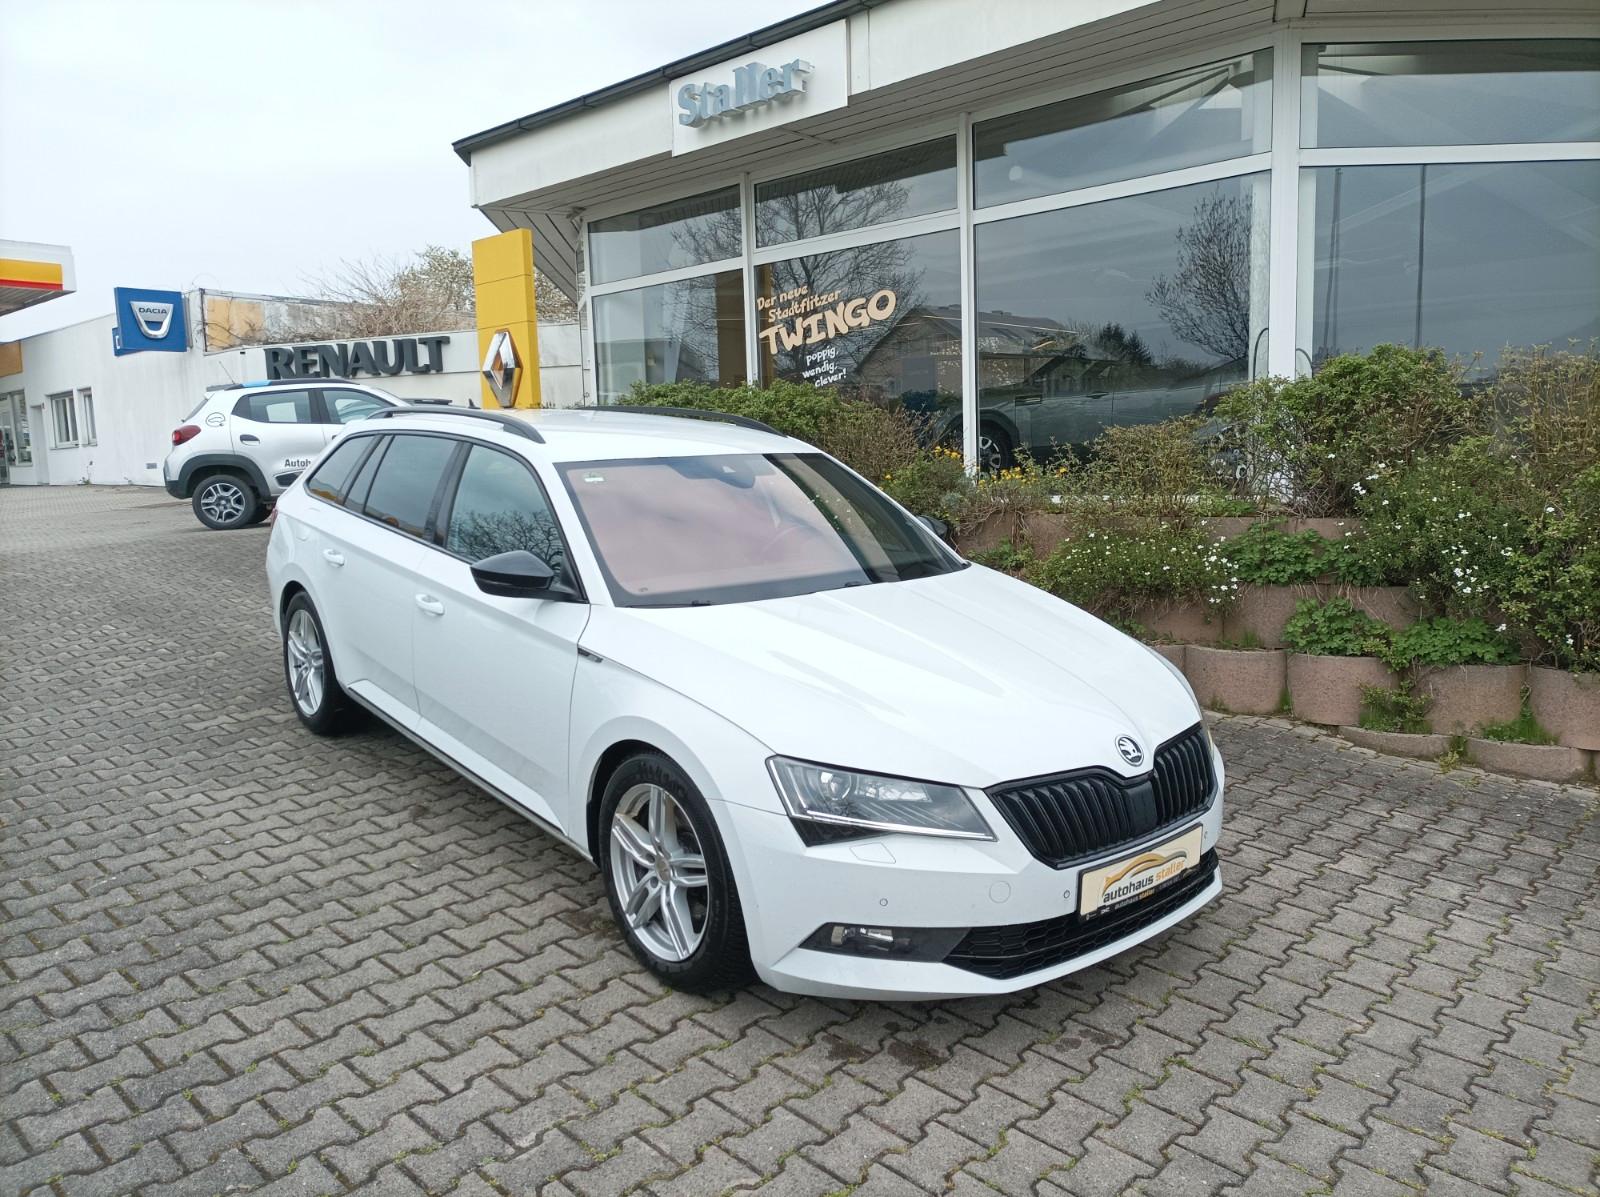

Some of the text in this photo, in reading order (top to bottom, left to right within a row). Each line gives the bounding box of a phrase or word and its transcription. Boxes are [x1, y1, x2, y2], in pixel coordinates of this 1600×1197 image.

[678, 58, 815, 128] Staller
[138, 307, 168, 315] DACIA
[757, 285, 809, 311] Der neue
[768, 290, 842, 322] Stadtflitzer
[759, 289, 897, 355] TWINGO
[264, 336, 450, 380] RENAULT
[814, 367, 847, 387] clever!
[1103, 875, 1154, 903] autohaus
[1155, 860, 1185, 881] staller
